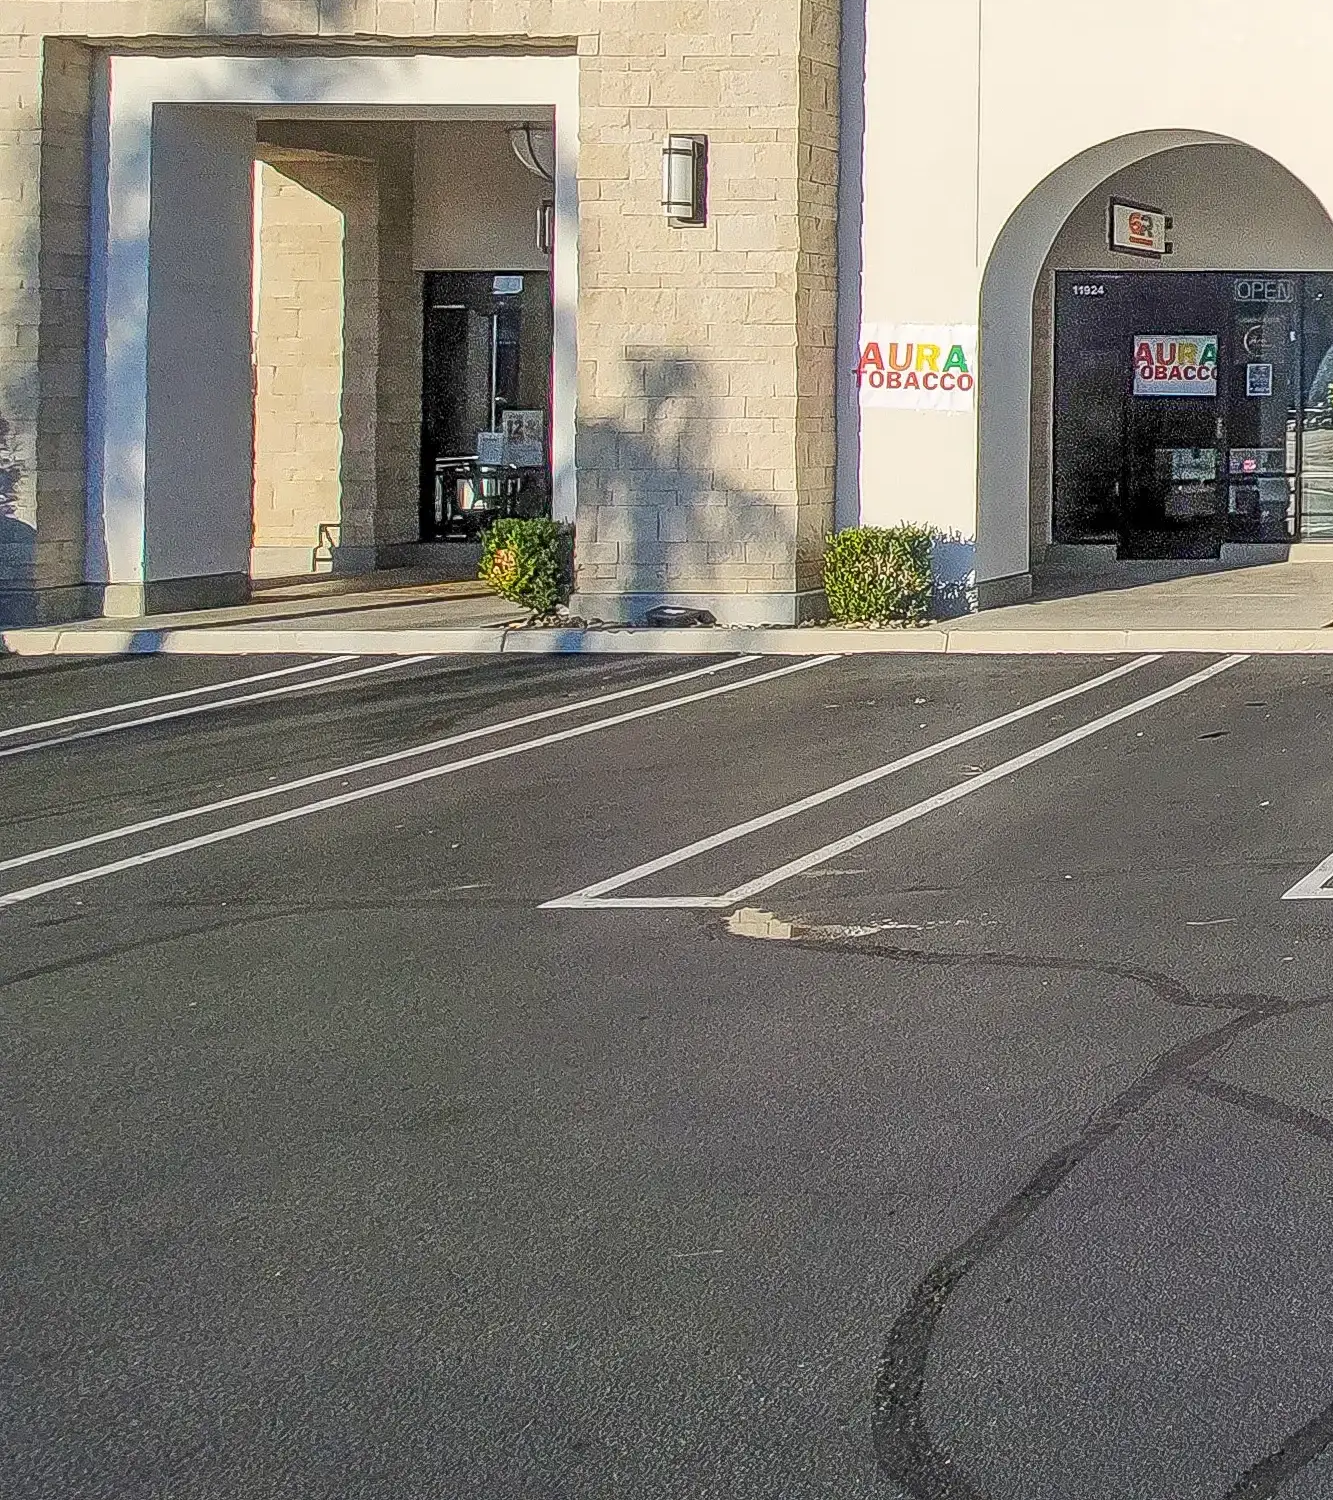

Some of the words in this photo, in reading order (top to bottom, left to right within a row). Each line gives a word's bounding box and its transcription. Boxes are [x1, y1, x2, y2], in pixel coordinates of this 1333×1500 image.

[1072, 283, 1105, 296] 11924
[1237, 281, 1291, 300] OPEN
[859, 342, 969, 372] AURA
[1134, 342, 1218, 366] AURA
[852, 369, 974, 391] TOBACCO
[1135, 365, 1218, 381] OBACC
